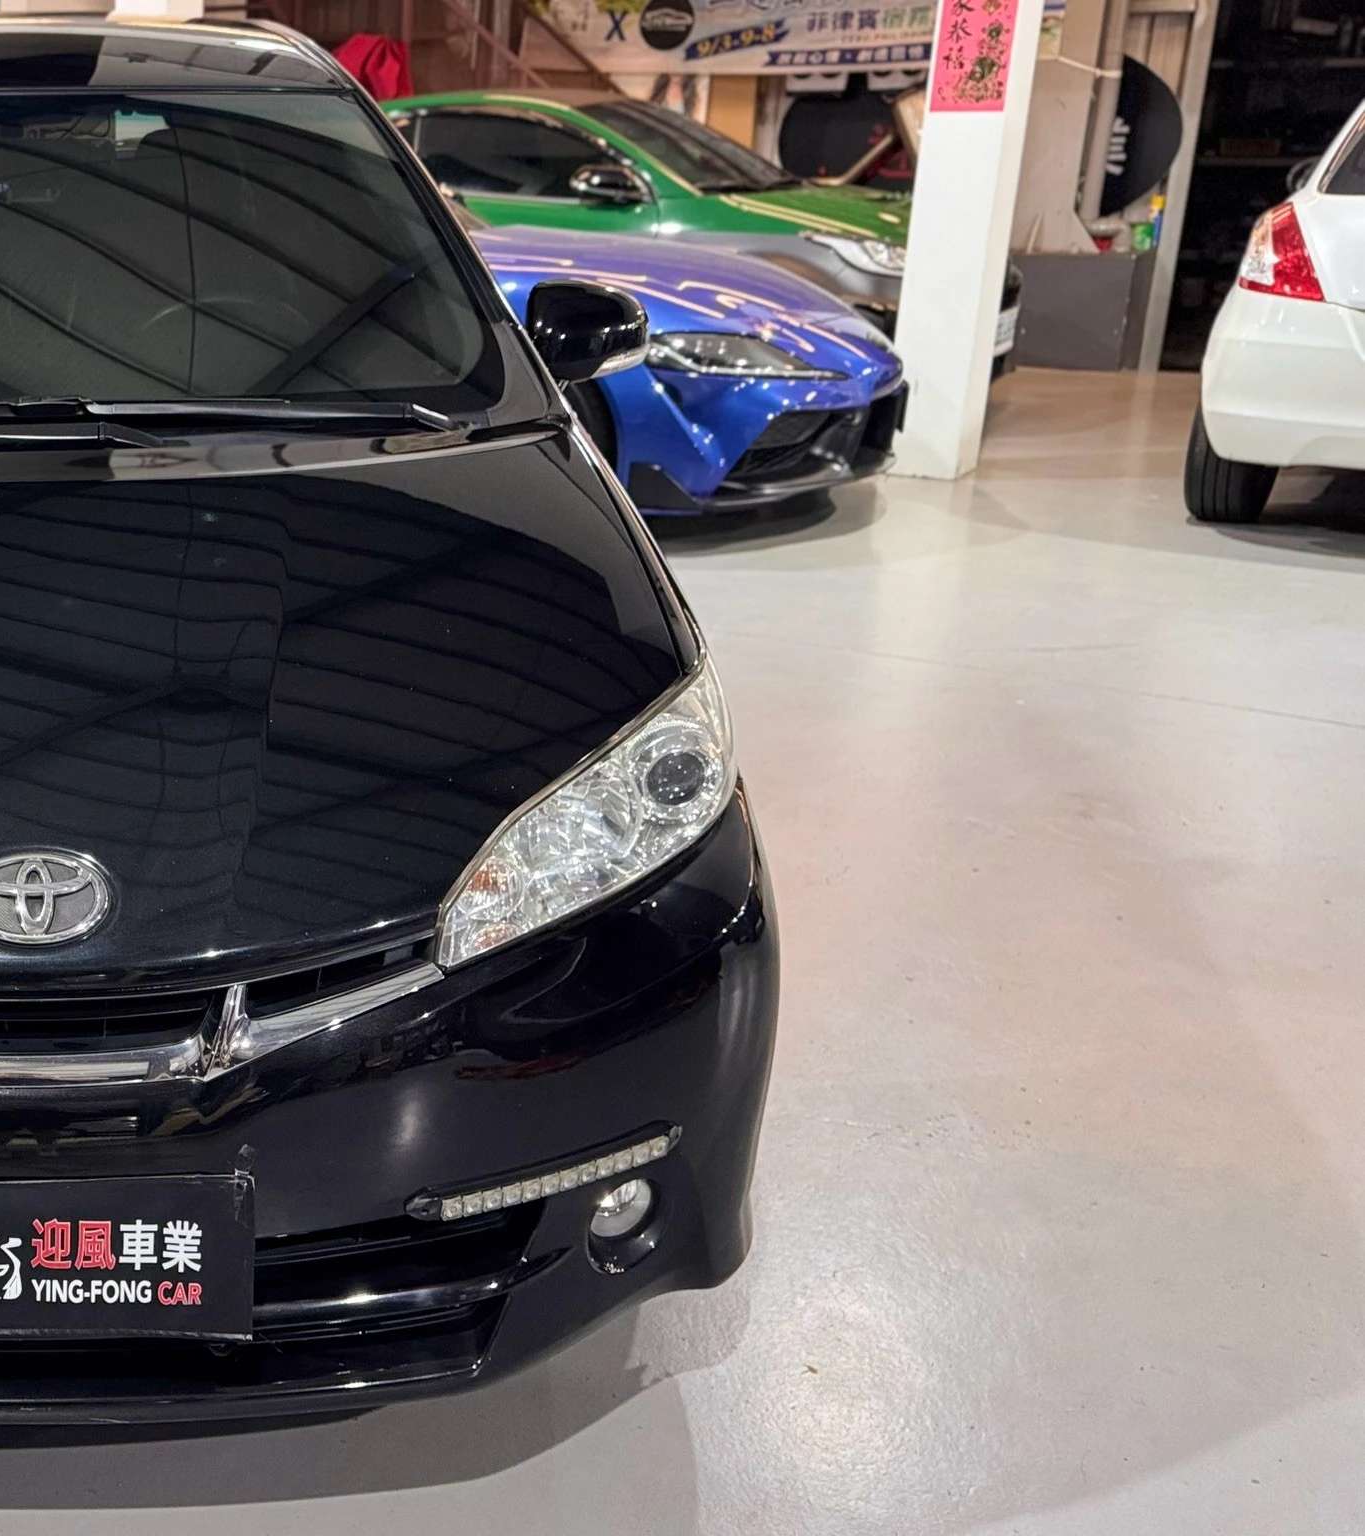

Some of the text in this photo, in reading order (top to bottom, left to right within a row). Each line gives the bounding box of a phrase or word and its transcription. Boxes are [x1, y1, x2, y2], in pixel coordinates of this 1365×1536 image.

[605, 9, 628, 41] X
[30, 1218, 202, 1273] 迎風車業
[31, 1279, 202, 1306] YING-FONG CAR
